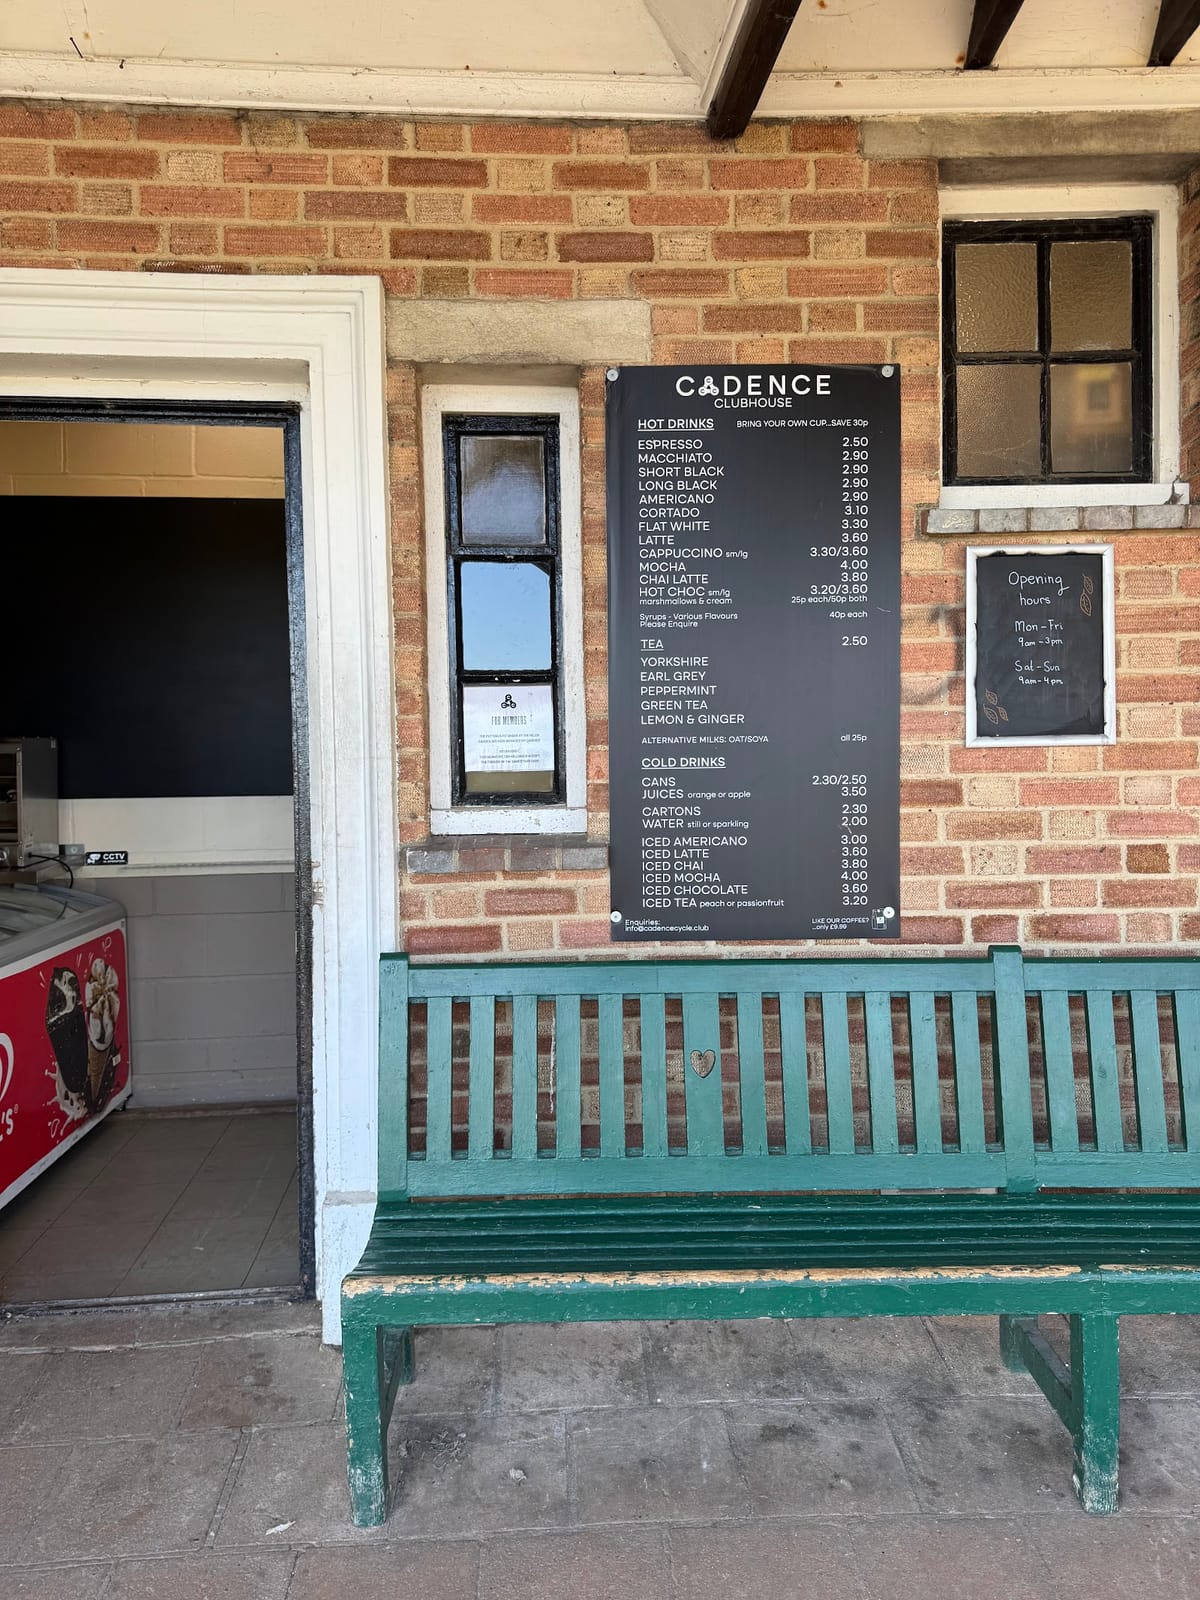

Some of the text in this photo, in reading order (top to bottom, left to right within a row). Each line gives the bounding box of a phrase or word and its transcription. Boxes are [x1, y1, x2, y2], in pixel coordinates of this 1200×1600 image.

[714, 398, 792, 408] CLUBHOUSE
[638, 419, 713, 429] HOT DRINKS
[853, 419, 868, 427] 30p
[639, 439, 702, 449] ESPRESSO
[843, 437, 868, 446] 2.50
[639, 453, 712, 463] MACCHIATO
[843, 451, 868, 460] 2.90
[639, 467, 724, 477] SHORT BLACK
[843, 464, 868, 474] 2.90
[639, 480, 717, 490] LONG BLACK
[843, 478, 868, 487] 2.90
[639, 494, 714, 504] AMERICANO
[842, 492, 868, 501] 2.90
[639, 508, 699, 518] CORTADO
[845, 505, 868, 515] 3.10
[639, 521, 710, 531] FLAT WHITE
[842, 519, 868, 529] 3.30
[639, 535, 674, 545] LATTE
[842, 533, 868, 542] 3.60
[640, 548, 748, 559] CAPPUCCINO sm/lg
[810, 546, 868, 556] 3.30/3.60
[640, 562, 686, 571] MOCHA
[840, 560, 868, 569] 4.00
[640, 574, 708, 584] CHAI LATTE
[842, 572, 868, 582] 3.80
[1009, 571, 1069, 596] Opening
[639, 587, 730, 597] HOT CHOC sm/lg
[811, 584, 867, 594] 3.20/3.60
[792, 596, 806, 604] 25p
[808, 595, 847, 604] each/50p
[1019, 592, 1051, 606] hours
[640, 614, 666, 622] Syrups
[829, 611, 846, 619] 40p
[668, 620, 698, 628] Enquire
[641, 640, 663, 648] TEA
[842, 636, 867, 645] 2.50
[641, 657, 708, 666] YORKSHIRE
[641, 672, 705, 681] EARL GREY
[641, 686, 717, 695] PEPPERMINT
[641, 700, 707, 710] GREEN TEA
[641, 714, 744, 724] LEMON & GINGER
[852, 734, 867, 742] 25p
[642, 757, 725, 768] COLD DRINKS
[642, 777, 675, 787] CANS
[813, 775, 866, 785] 2.30/2.50
[643, 789, 683, 799] JUICES
[728, 791, 750, 799] apple
[842, 786, 866, 796] 3.50
[643, 807, 700, 816] CARTONS
[843, 804, 867, 813] 2.30
[643, 819, 683, 828] WATER
[713, 820, 748, 829] sparkling
[842, 816, 867, 826] 2.00
[642, 836, 747, 846] ICED AMERICANO
[841, 835, 867, 844] 3.00
[642, 849, 709, 858] ICED LATTE
[842, 847, 867, 856] 3.60
[643, 861, 703, 871] ICED CHAI
[842, 859, 867, 868] 3.80
[643, 873, 720, 883] ICED MOCHA
[841, 871, 867, 880] 4.00
[643, 885, 748, 895] ICED CHOCOLATE
[842, 884, 867, 893] 3.60
[643, 898, 671, 907] ICED
[674, 898, 697, 907] TEA
[700, 900, 725, 908] peach
[737, 899, 784, 908] passionfruit
[843, 896, 867, 905] 3.20
[626, 919, 660, 927] Enquiries:
[625, 924, 709, 933] info@cadencecycle.club
